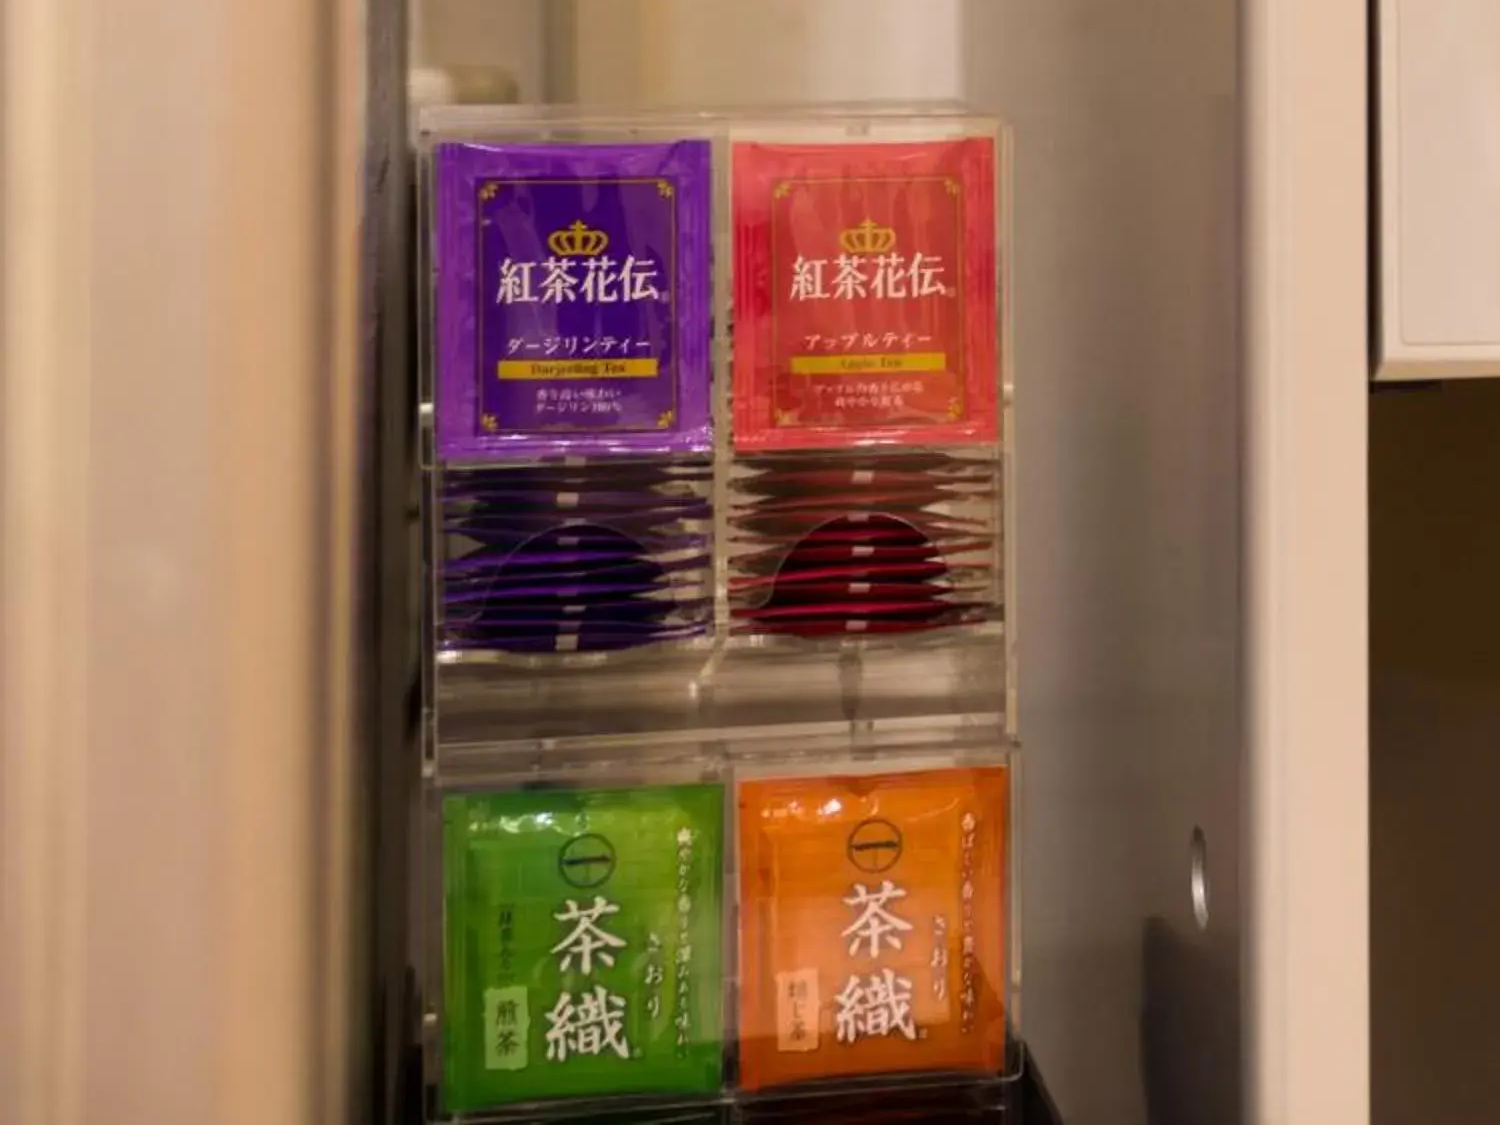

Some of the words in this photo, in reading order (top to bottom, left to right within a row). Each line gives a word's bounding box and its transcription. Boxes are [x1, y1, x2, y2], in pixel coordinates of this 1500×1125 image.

[495, 254, 660, 305] 紅茶花伝
[789, 252, 947, 302] 紅茶花伝
[507, 336, 651, 355] ダージリンティー
[804, 332, 932, 351] アップルティー
[544, 895, 631, 1062] 茶織
[836, 879, 919, 1045] 茶織
